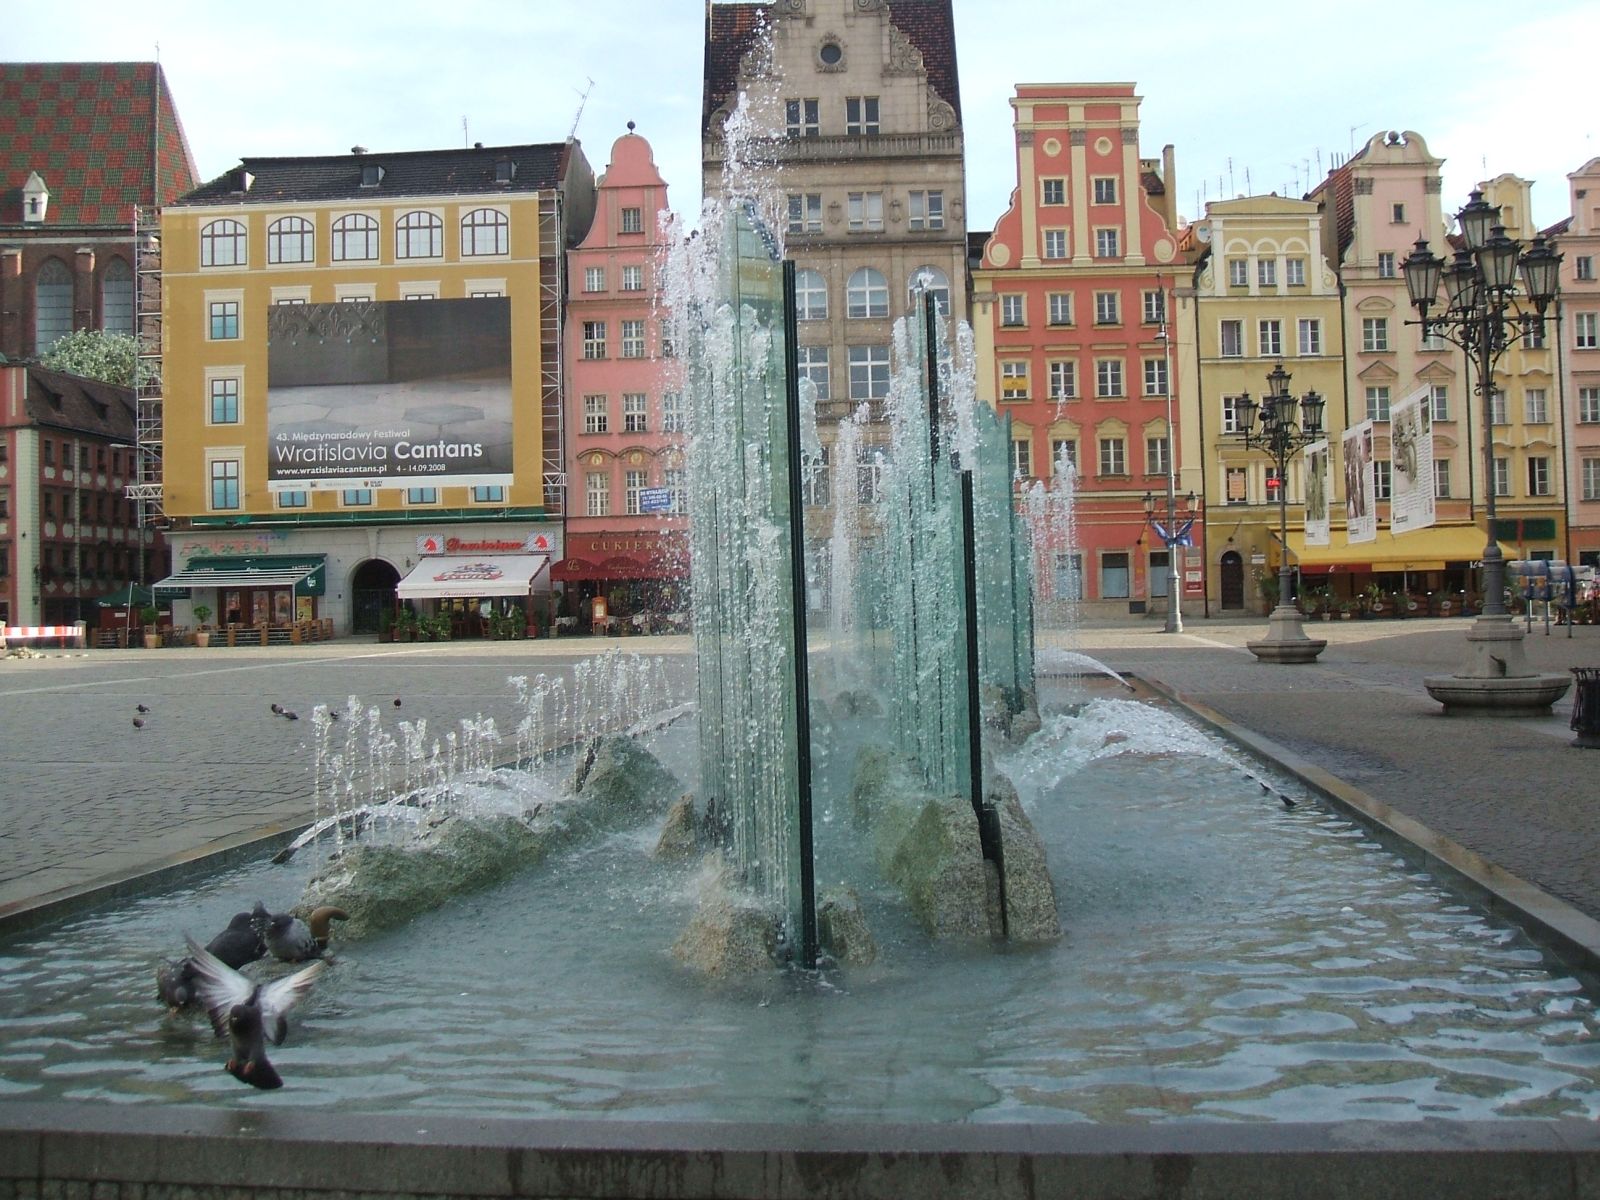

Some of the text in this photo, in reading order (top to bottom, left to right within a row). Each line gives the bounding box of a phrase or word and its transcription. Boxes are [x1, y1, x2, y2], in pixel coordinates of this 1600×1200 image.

[276, 429, 410, 442] 43. Międzynarodowy Festiwal
[276, 440, 483, 462] Wratislavia Cantans
[276, 464, 387, 475] www.wratislaviacantans.pl
[408, 463, 446, 472] 14.09.2008
